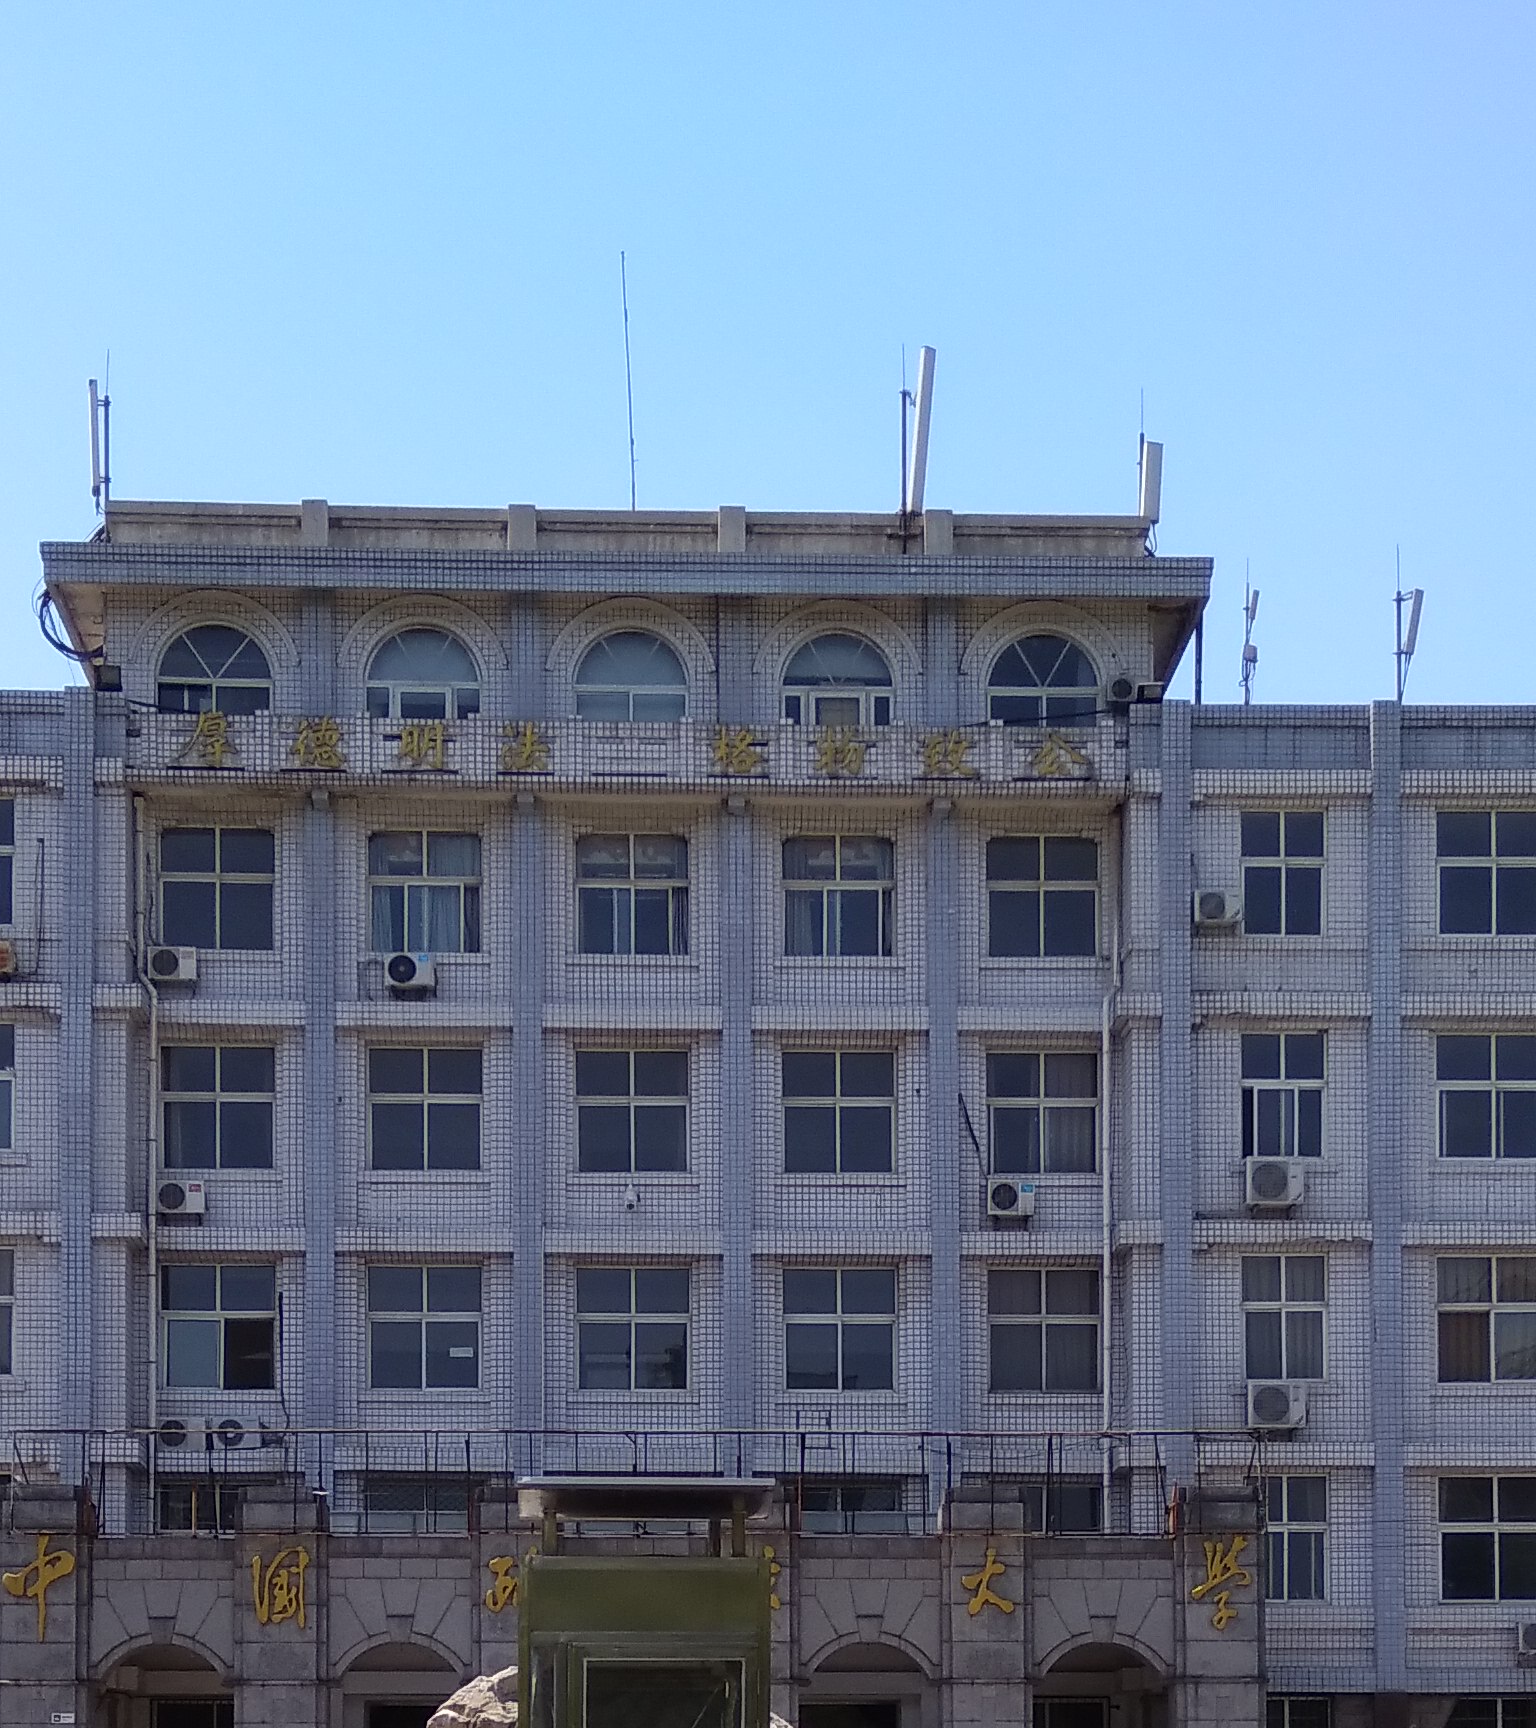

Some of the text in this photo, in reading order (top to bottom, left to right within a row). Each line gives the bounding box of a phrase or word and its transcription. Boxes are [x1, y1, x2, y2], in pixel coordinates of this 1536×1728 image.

[177, 711, 1092, 776] 厚德明法 格物致公
